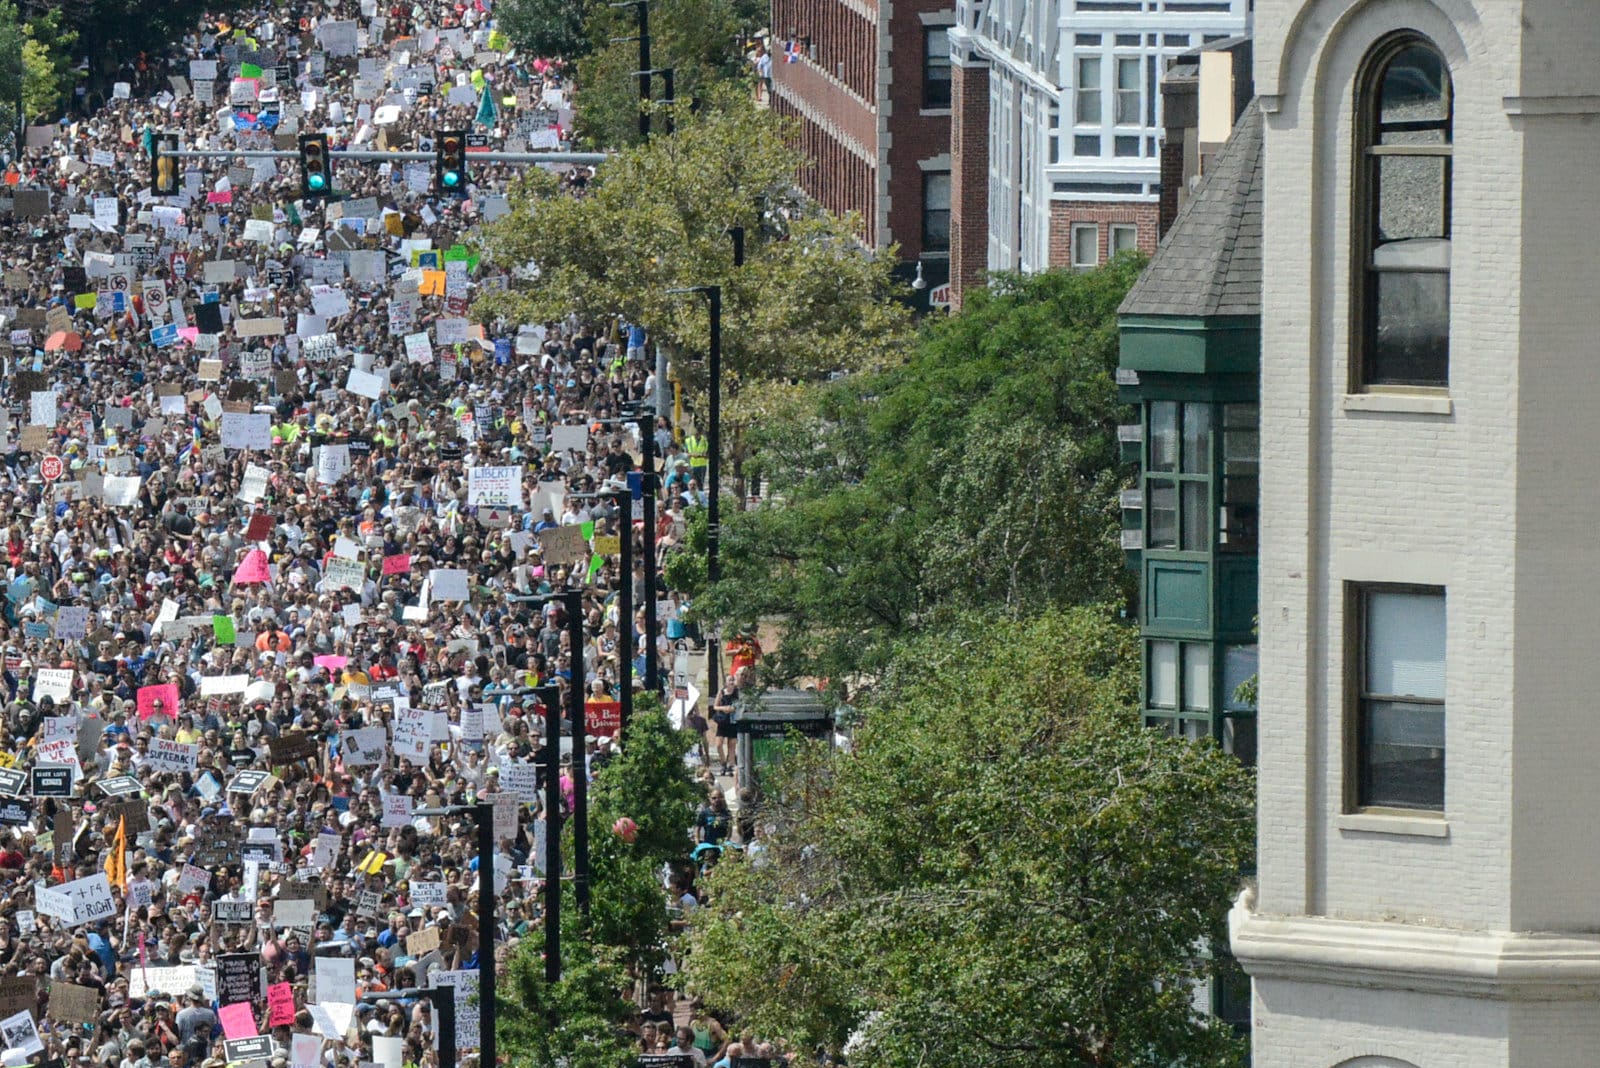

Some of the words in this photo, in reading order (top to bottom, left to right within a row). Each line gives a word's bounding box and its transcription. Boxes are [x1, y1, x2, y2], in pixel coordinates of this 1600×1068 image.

[475, 469, 517, 478] LIBERTY
[400, 709, 424, 719] STOP
[591, 719, 620, 728] Univers
